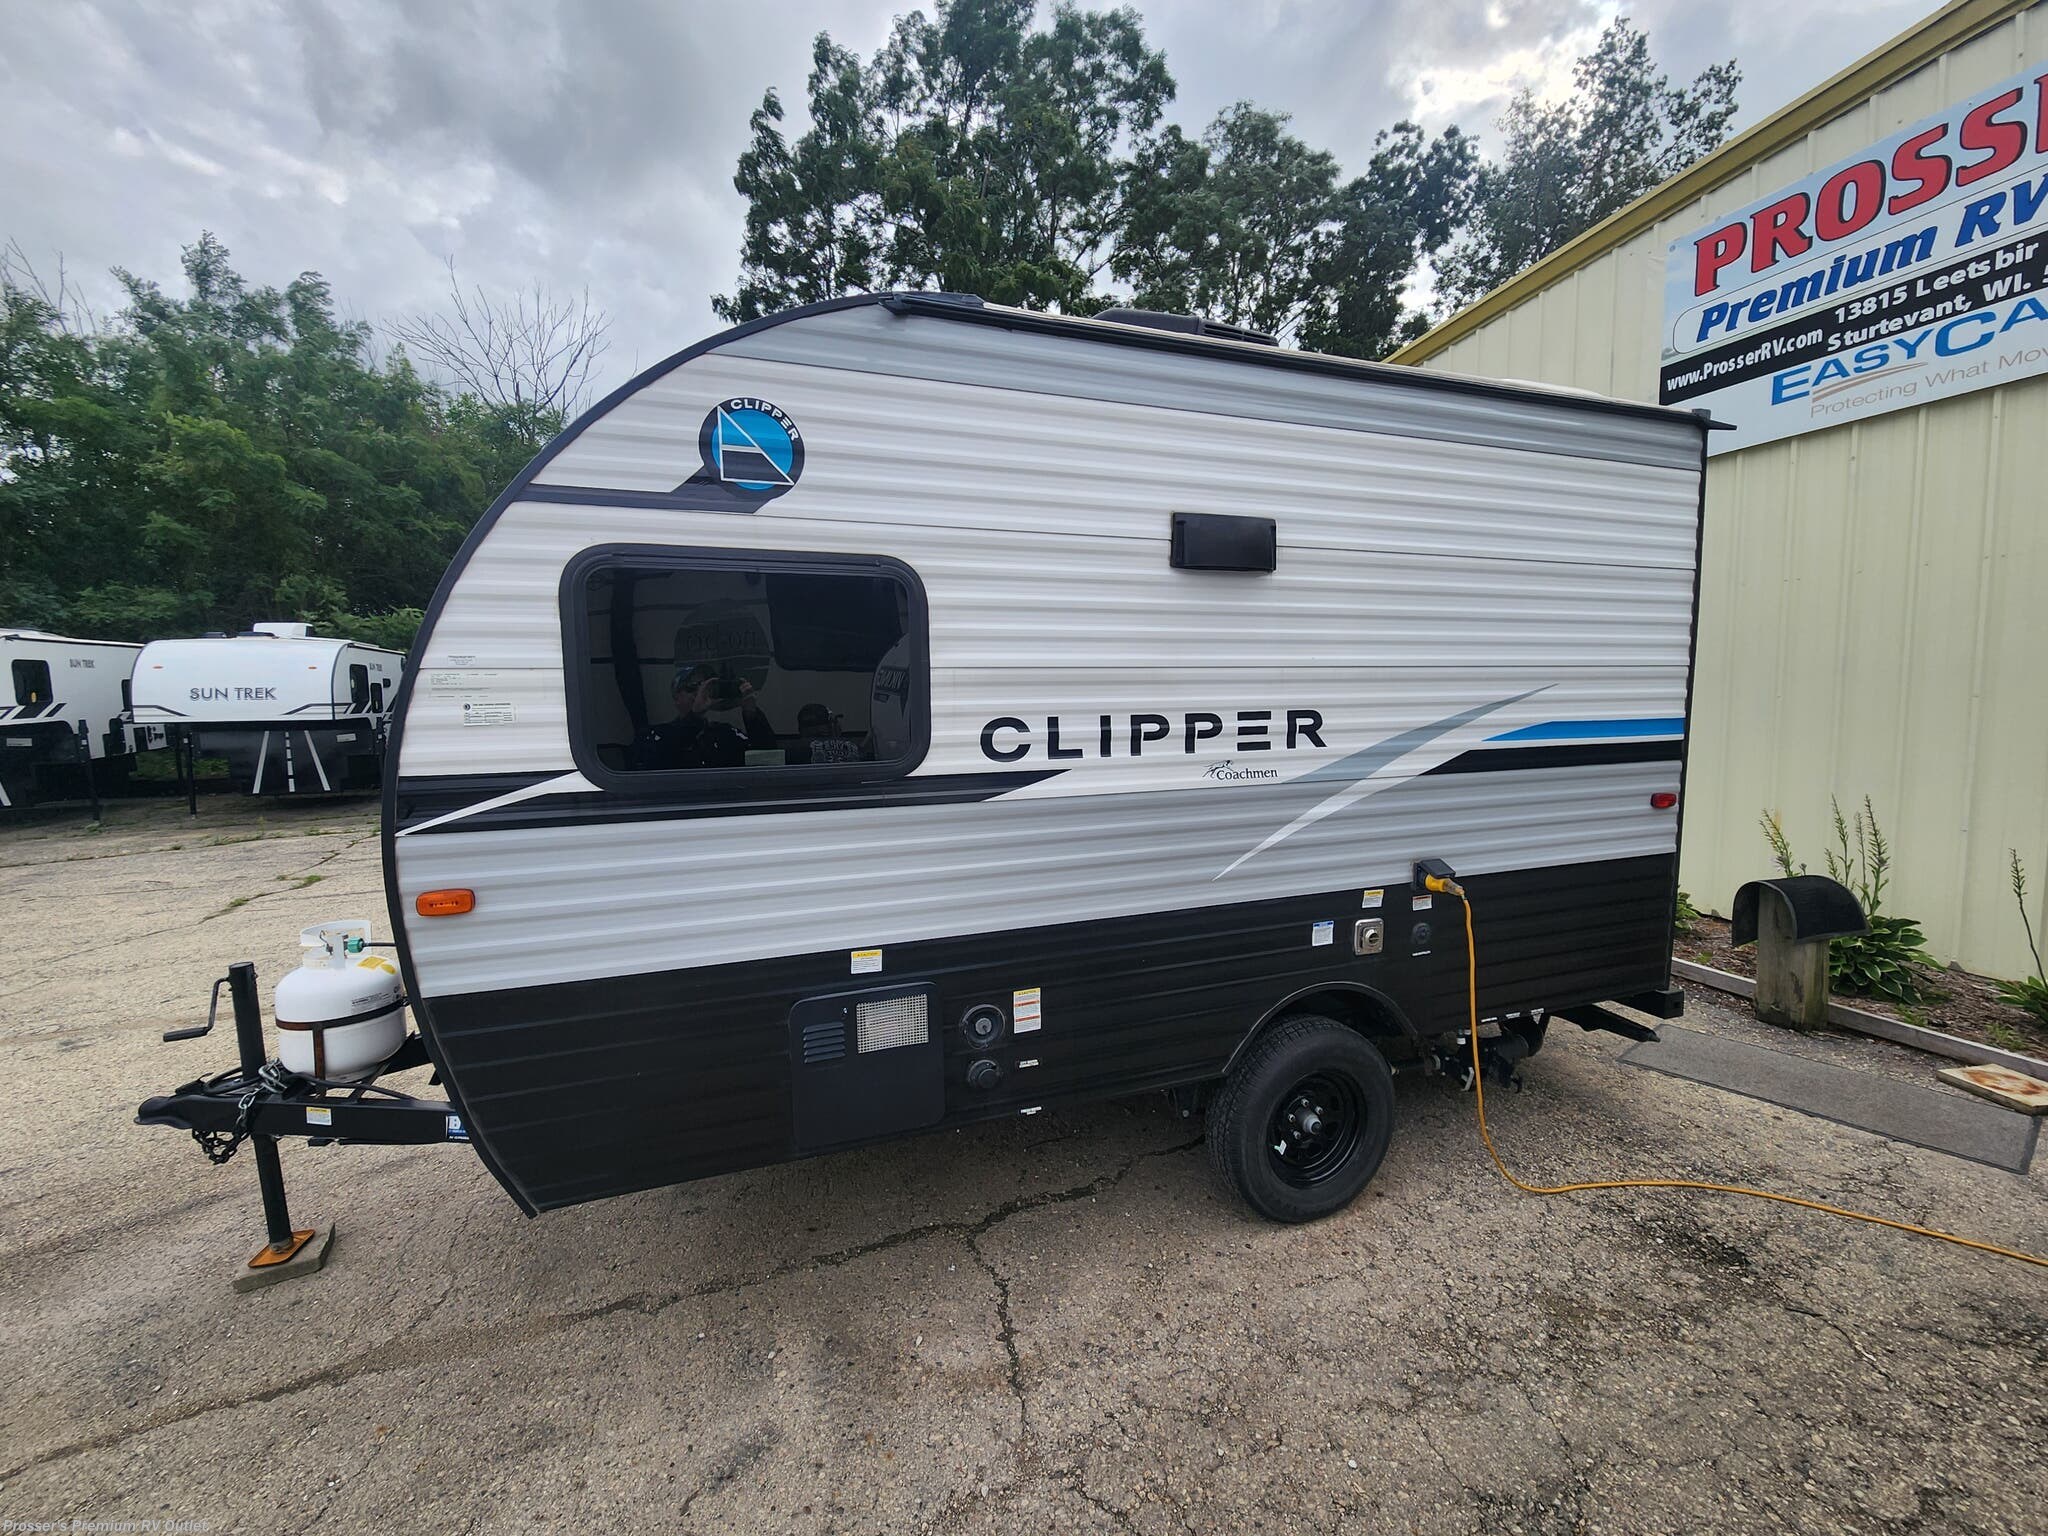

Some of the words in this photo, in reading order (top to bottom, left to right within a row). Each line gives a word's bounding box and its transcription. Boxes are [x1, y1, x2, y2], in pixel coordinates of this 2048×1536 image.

[1693, 72, 2048, 297] PROSS
[1696, 225, 1939, 343] Premium
[1955, 173, 2048, 248] RV
[1827, 293, 1973, 352] Sturtevant,
[1982, 273, 2032, 302] WI.
[1835, 286, 1908, 324] 13815
[1666, 328, 1824, 392] www.ProsserRV.com
[1809, 379, 1918, 418] Protecting
[1925, 361, 1989, 388] What
[730, 398, 800, 441] CLIPPER
[190, 687, 229, 701] SUN
[234, 687, 277, 701] TREK
[979, 709, 1328, 763] CLIPPER
[1216, 768, 1278, 781] Coachmen
